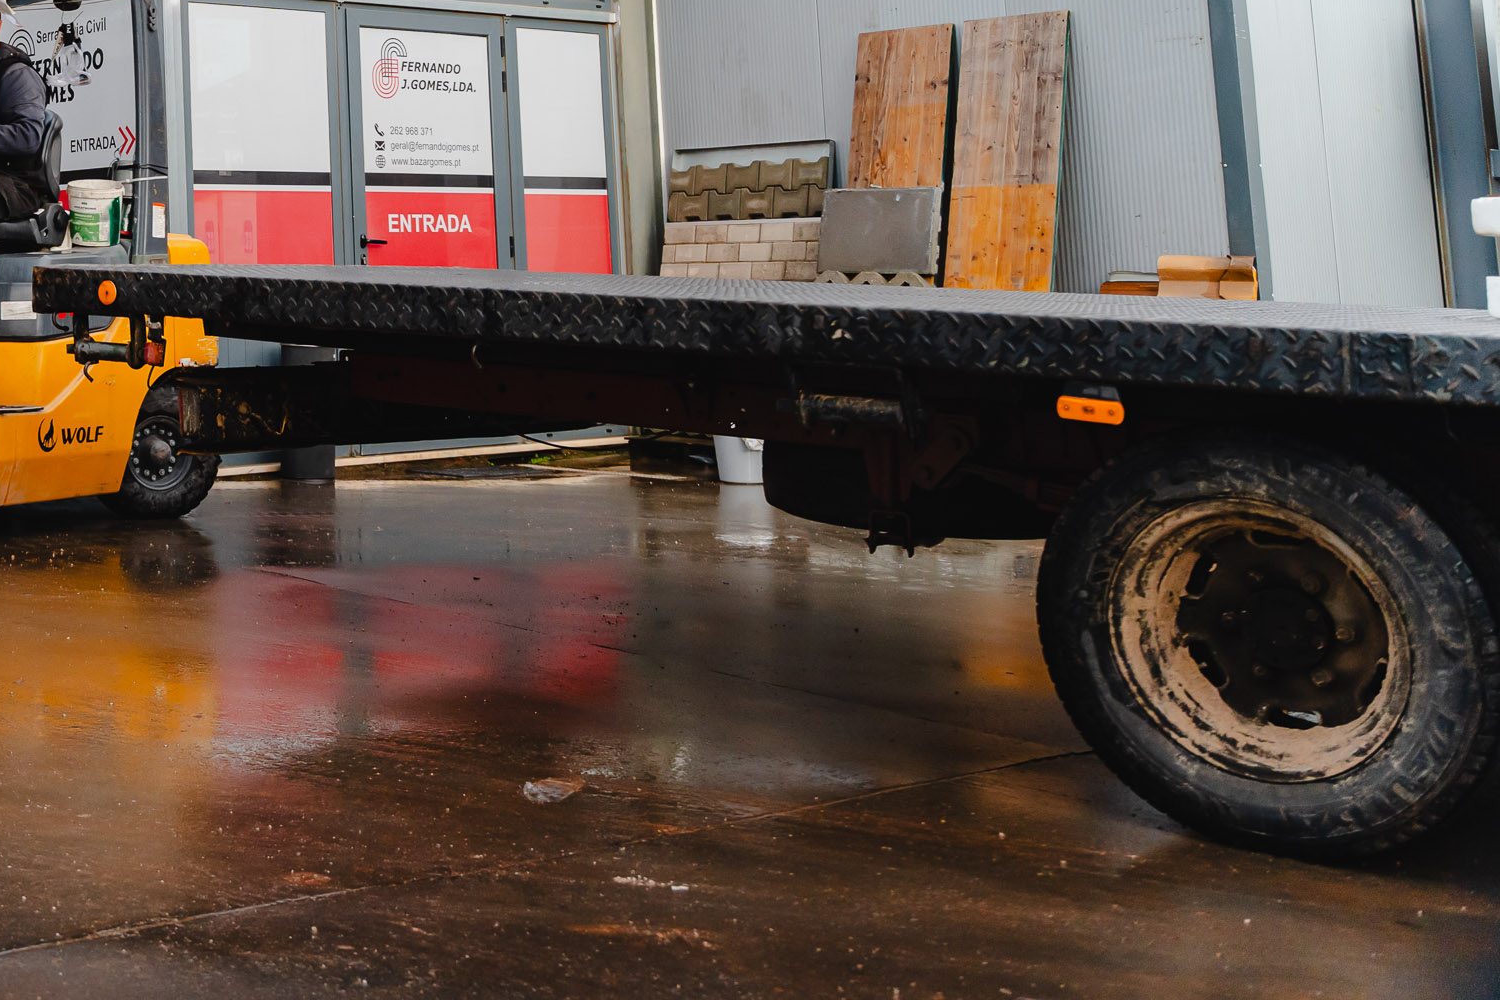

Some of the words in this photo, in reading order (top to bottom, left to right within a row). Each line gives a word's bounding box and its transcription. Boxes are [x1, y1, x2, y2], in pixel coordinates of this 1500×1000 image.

[36, 21, 84, 44] Serraia
[86, 16, 107, 33] Civil
[32, 47, 104, 78] ERNDO
[401, 61, 461, 75] FERNANDO
[45, 84, 75, 105] MES
[401, 79, 476, 93] J.GOMES,LDA.
[390, 126, 403, 135] 262
[405, 127, 419, 135] 968
[420, 127, 433, 135] 371
[70, 136, 117, 153] ENTRADA
[390, 141, 480, 153] geral@fernandojgomes.pt
[391, 157, 462, 168] www.bazargomes.pt
[388, 213, 472, 233] ENTRADA
[61, 425, 104, 445] WOLF
